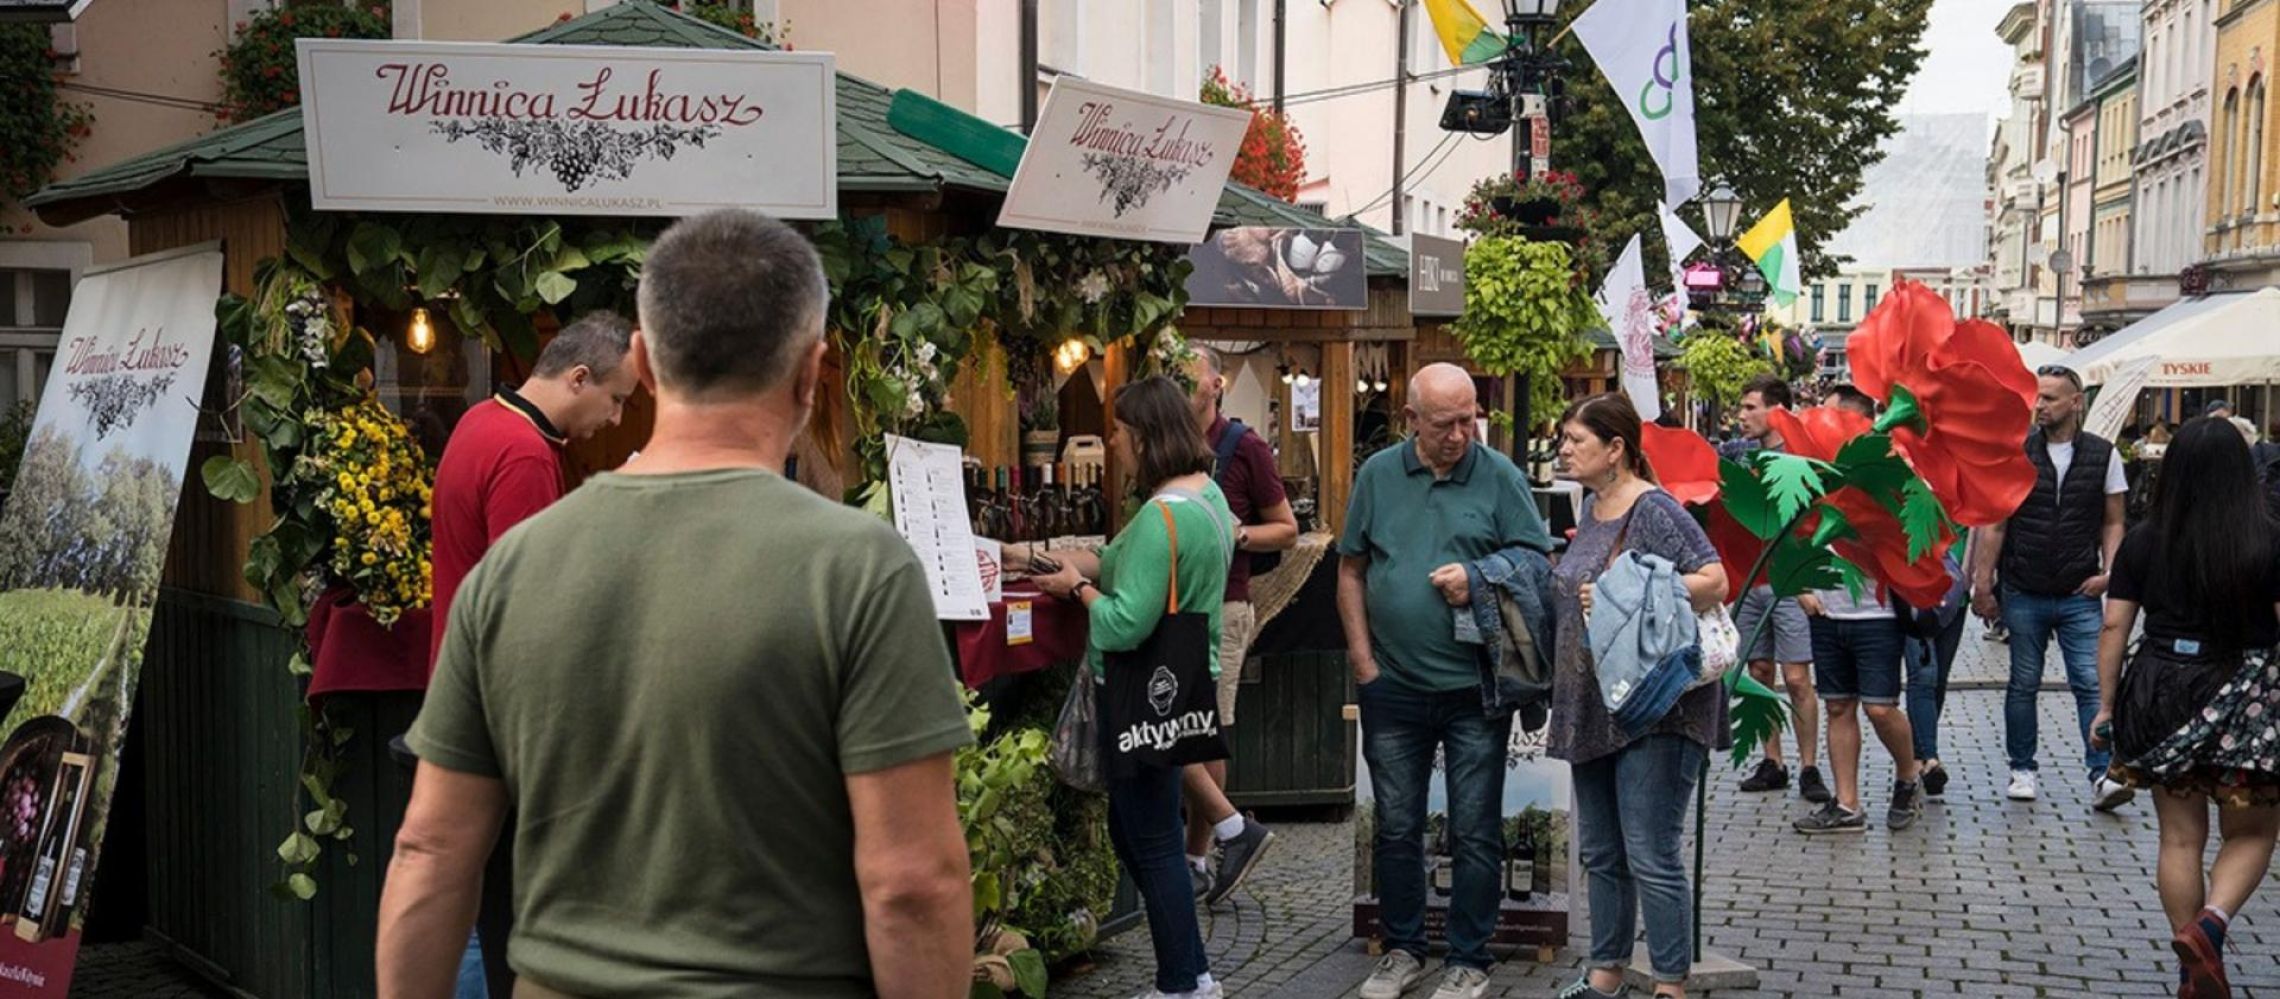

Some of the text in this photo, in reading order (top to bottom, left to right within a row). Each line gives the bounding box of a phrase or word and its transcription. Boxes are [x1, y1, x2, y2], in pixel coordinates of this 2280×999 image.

[376, 63, 763, 125] Winnica Łukasz
[1070, 101, 1213, 168] Winnica Łukasz
[2161, 362, 2211, 375] TYSKIE
[1118, 710, 1215, 753] aktywny
